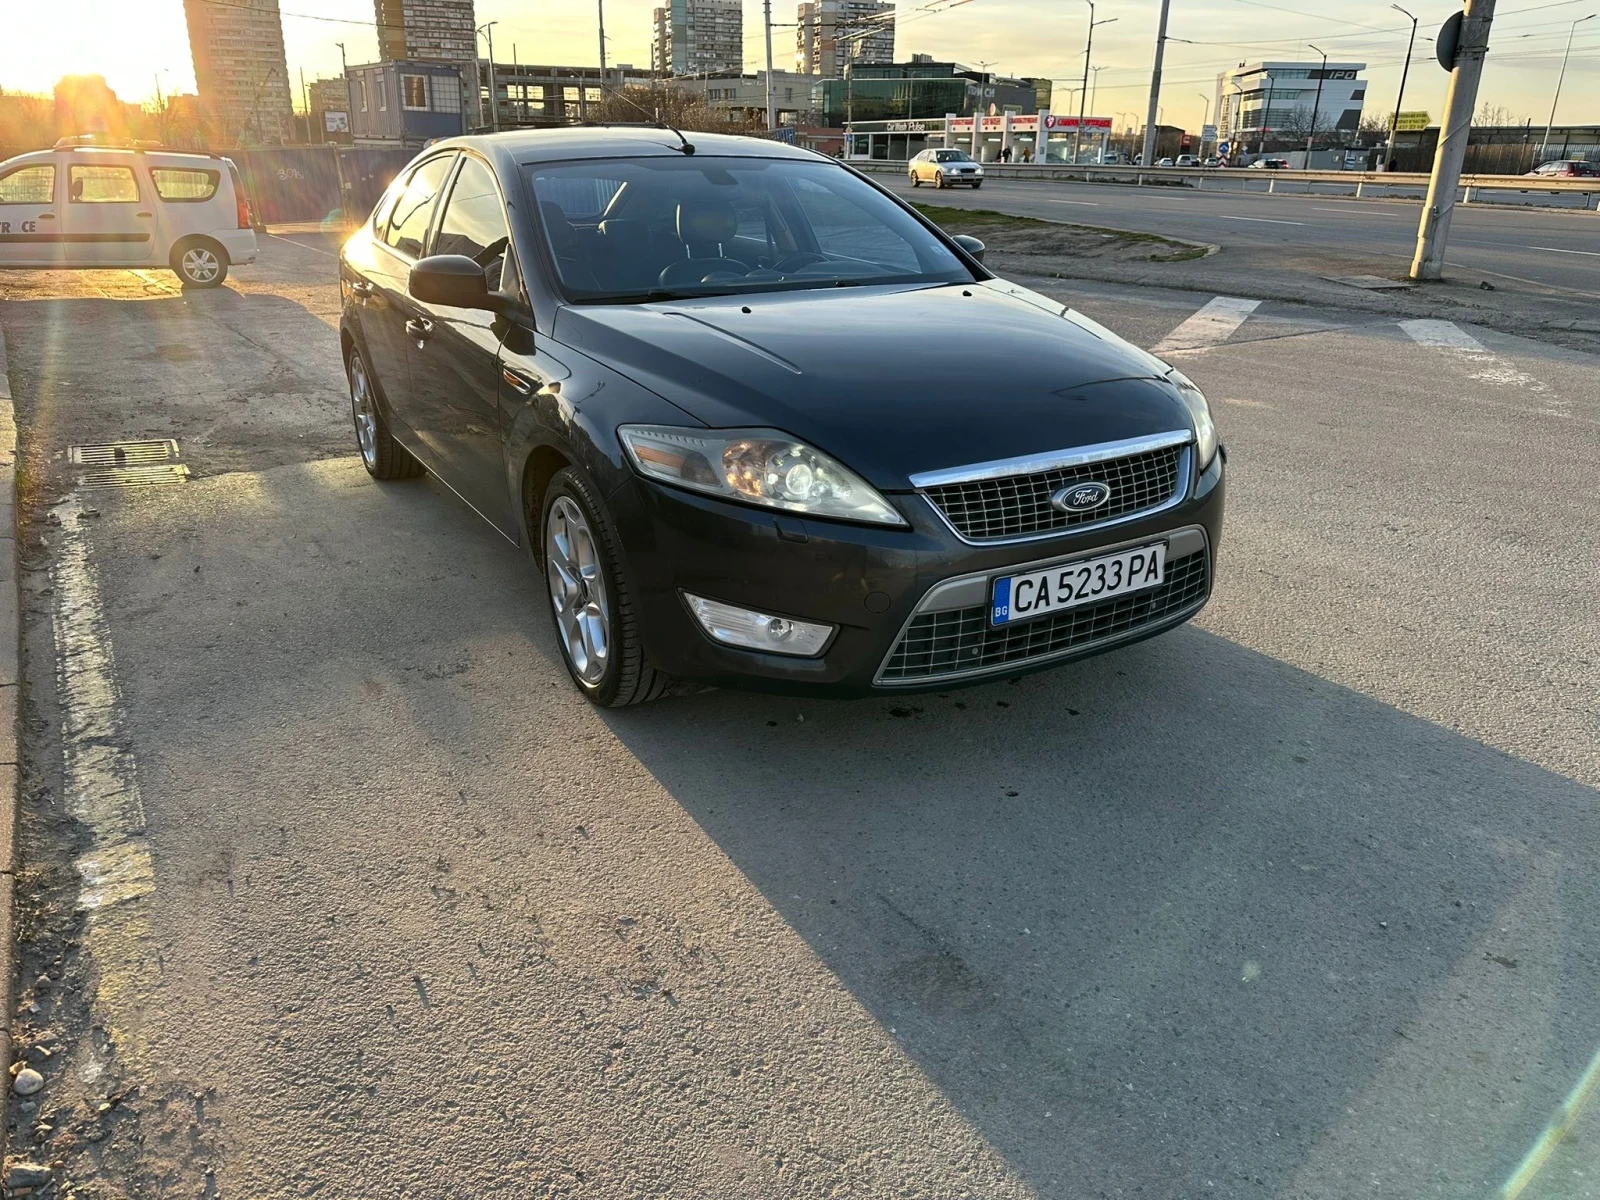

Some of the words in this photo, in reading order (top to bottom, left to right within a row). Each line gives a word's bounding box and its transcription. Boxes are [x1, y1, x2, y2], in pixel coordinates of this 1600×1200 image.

[1329, 71, 1356, 79] IPO
[908, 120, 925, 131] Pulse
[1073, 489, 1098, 505] Ford
[995, 606, 1008, 617] BG
